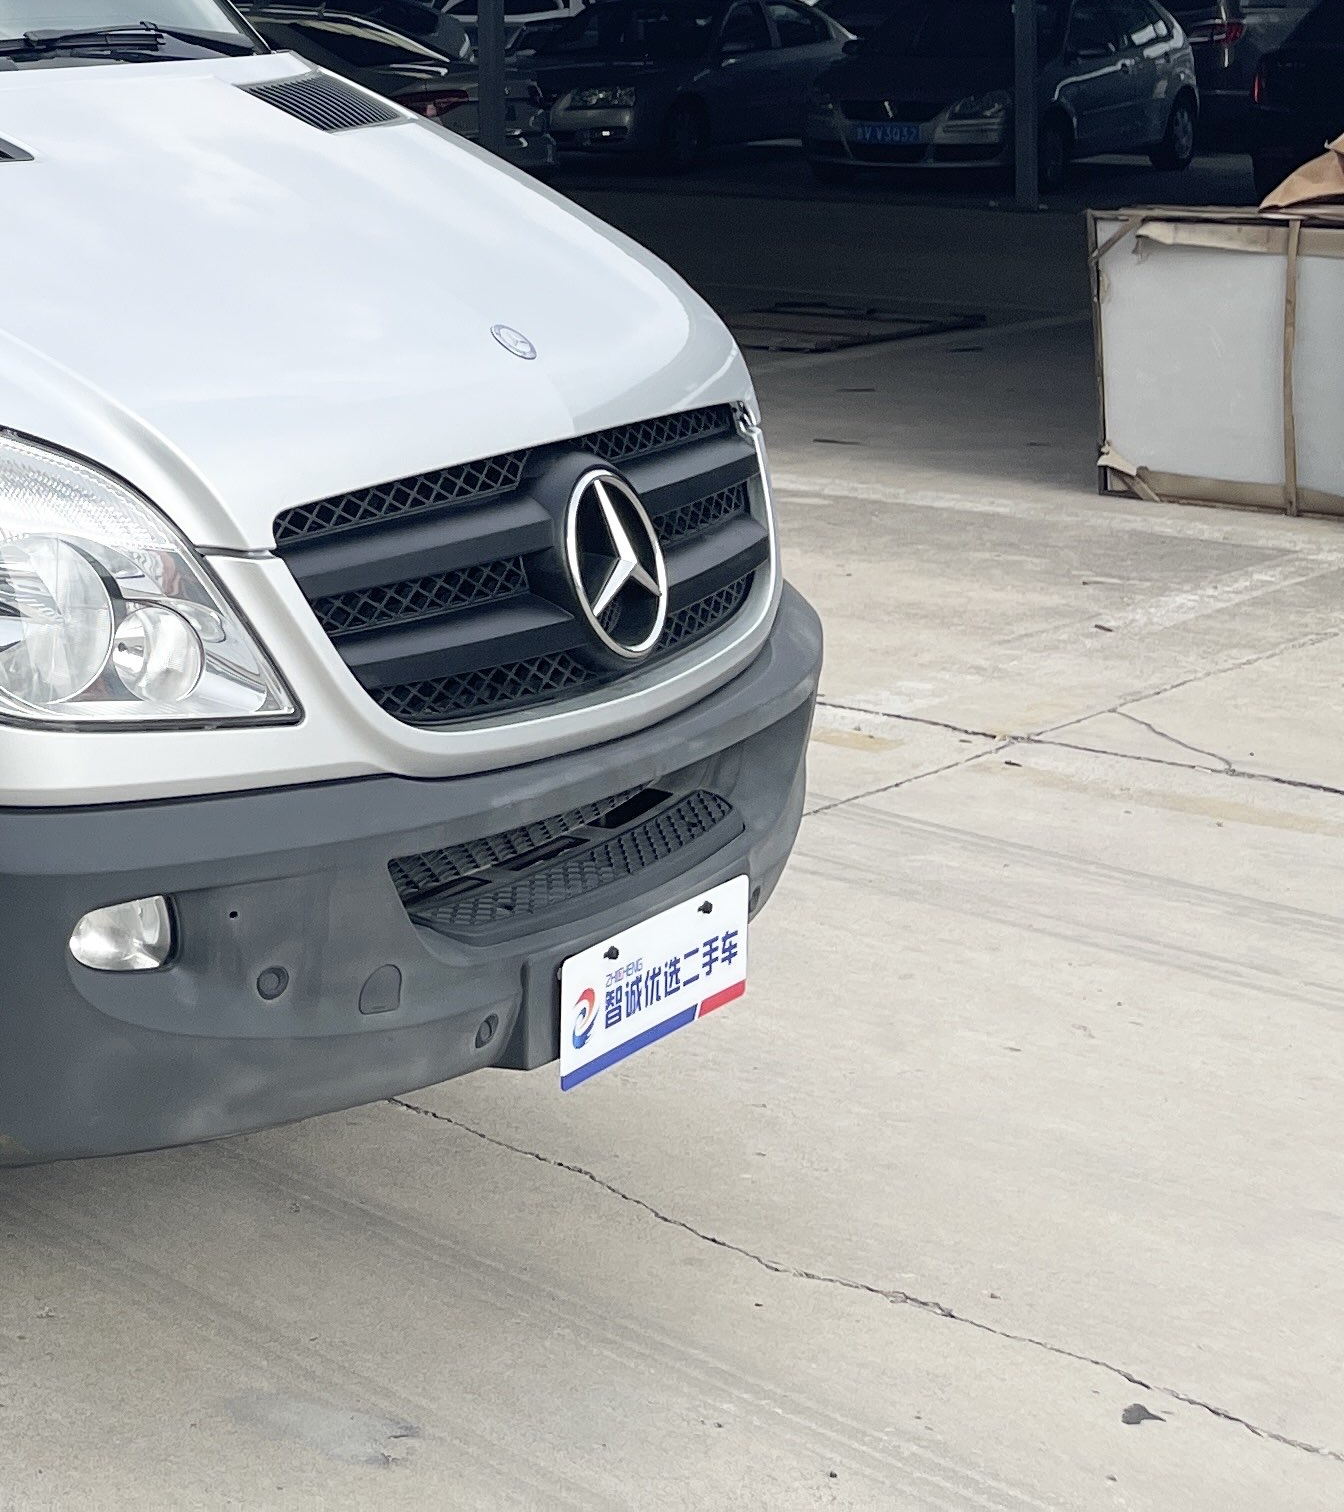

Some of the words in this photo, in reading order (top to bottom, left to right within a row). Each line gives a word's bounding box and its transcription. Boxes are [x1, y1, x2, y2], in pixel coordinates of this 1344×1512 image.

[605, 930, 739, 1029] 智诚优选二手车
